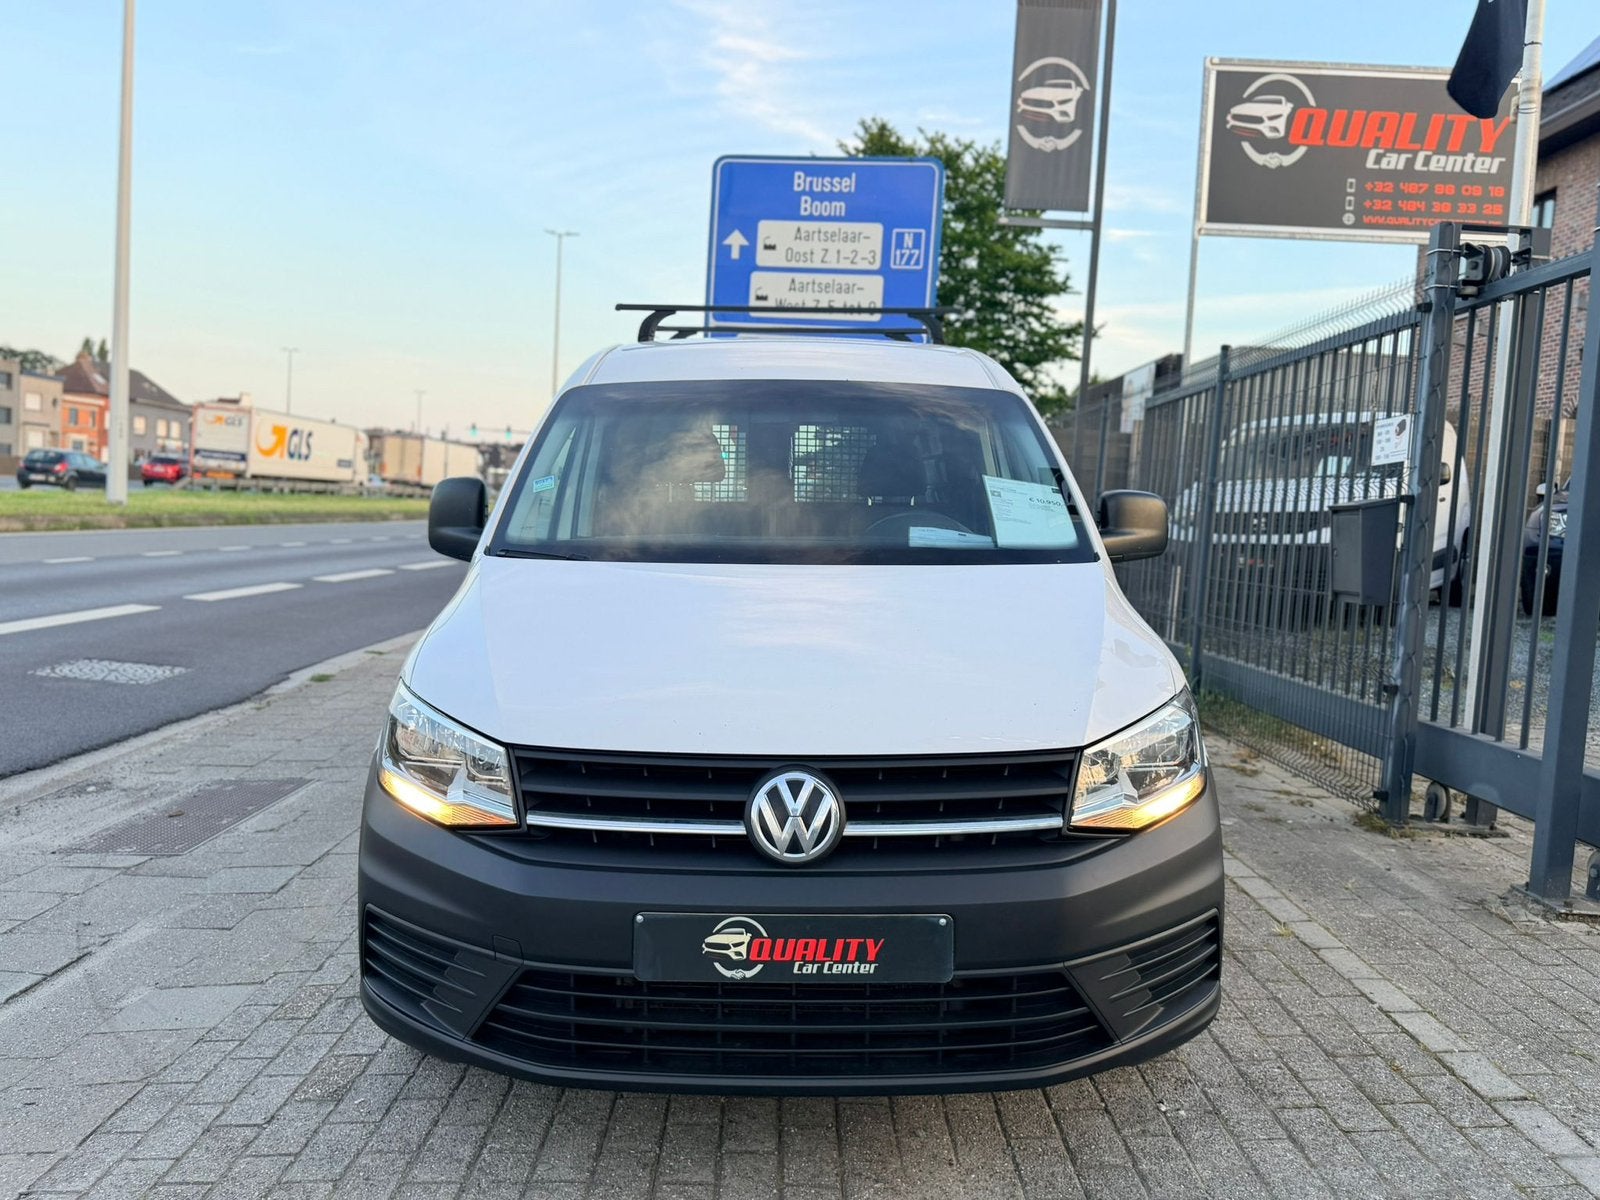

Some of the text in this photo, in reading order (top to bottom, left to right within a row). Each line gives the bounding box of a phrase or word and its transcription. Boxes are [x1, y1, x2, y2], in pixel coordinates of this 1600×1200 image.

[1289, 107, 1511, 152] QUALITY
[1366, 148, 1505, 174] Car Center
[793, 171, 856, 193] Brussel
[800, 196, 846, 216] Boom
[794, 226, 871, 244] Aartselaar-
[904, 232, 914, 249] N
[785, 246, 814, 264] Oost
[894, 250, 919, 266] 177
[788, 278, 864, 295] Aartselaar-
[288, 428, 313, 461] GLS
[749, 938, 885, 961] QUALITY
[793, 961, 878, 974] Car Center
